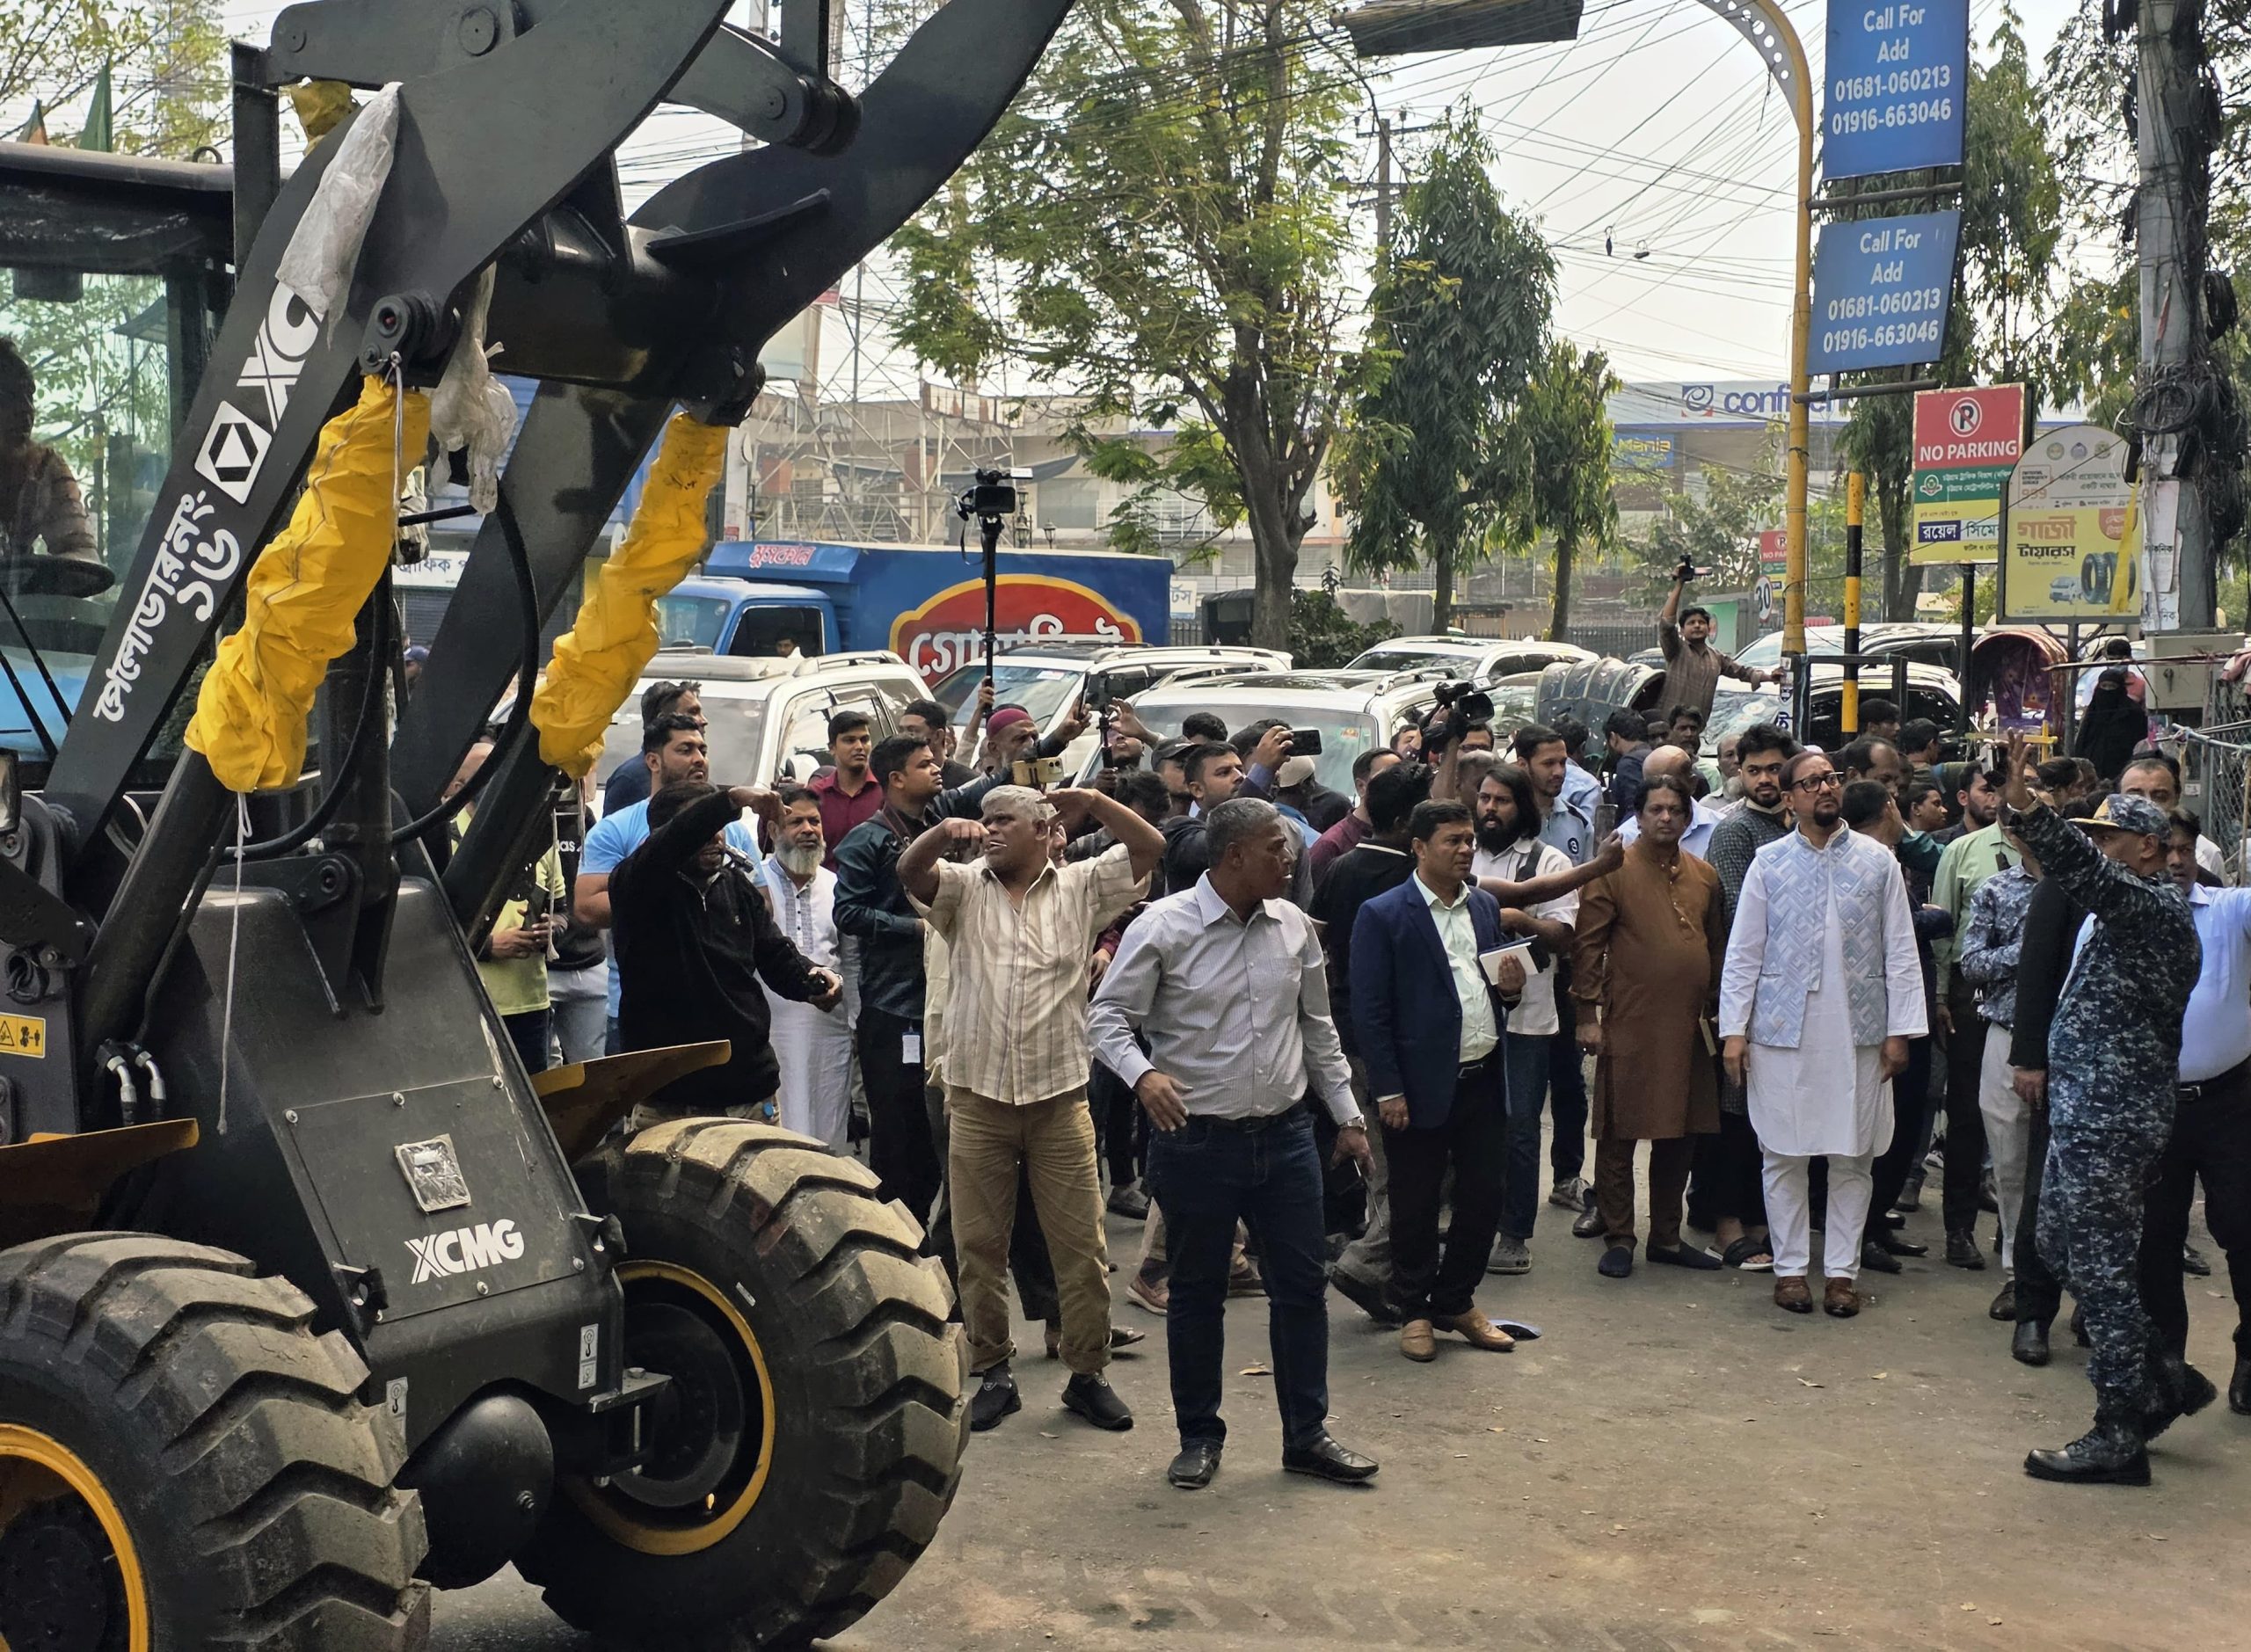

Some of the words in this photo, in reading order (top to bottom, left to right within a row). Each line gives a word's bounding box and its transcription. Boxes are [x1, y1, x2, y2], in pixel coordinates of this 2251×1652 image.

[1863, 7, 1893, 32] Call
[1899, 4, 1925, 27] For
[1876, 37, 1909, 63] Add
[1835, 65, 1950, 102] 01681-060213
[1832, 98, 1951, 135] 01916-663046
[1860, 230, 1890, 253] Call
[1895, 229, 1921, 251] For
[1870, 260, 1904, 285] Add
[1828, 287, 1941, 321] 01681-060213
[1824, 319, 1939, 353] 01916-663046
[1920, 445, 1944, 462] NO
[1948, 440, 2017, 460] PARKING
[1922, 524, 1957, 540] রয়েল
[1966, 520, 1999, 538] সিমে
[2017, 515, 2077, 540] গাজী
[404, 1219, 525, 1284] XCMG
